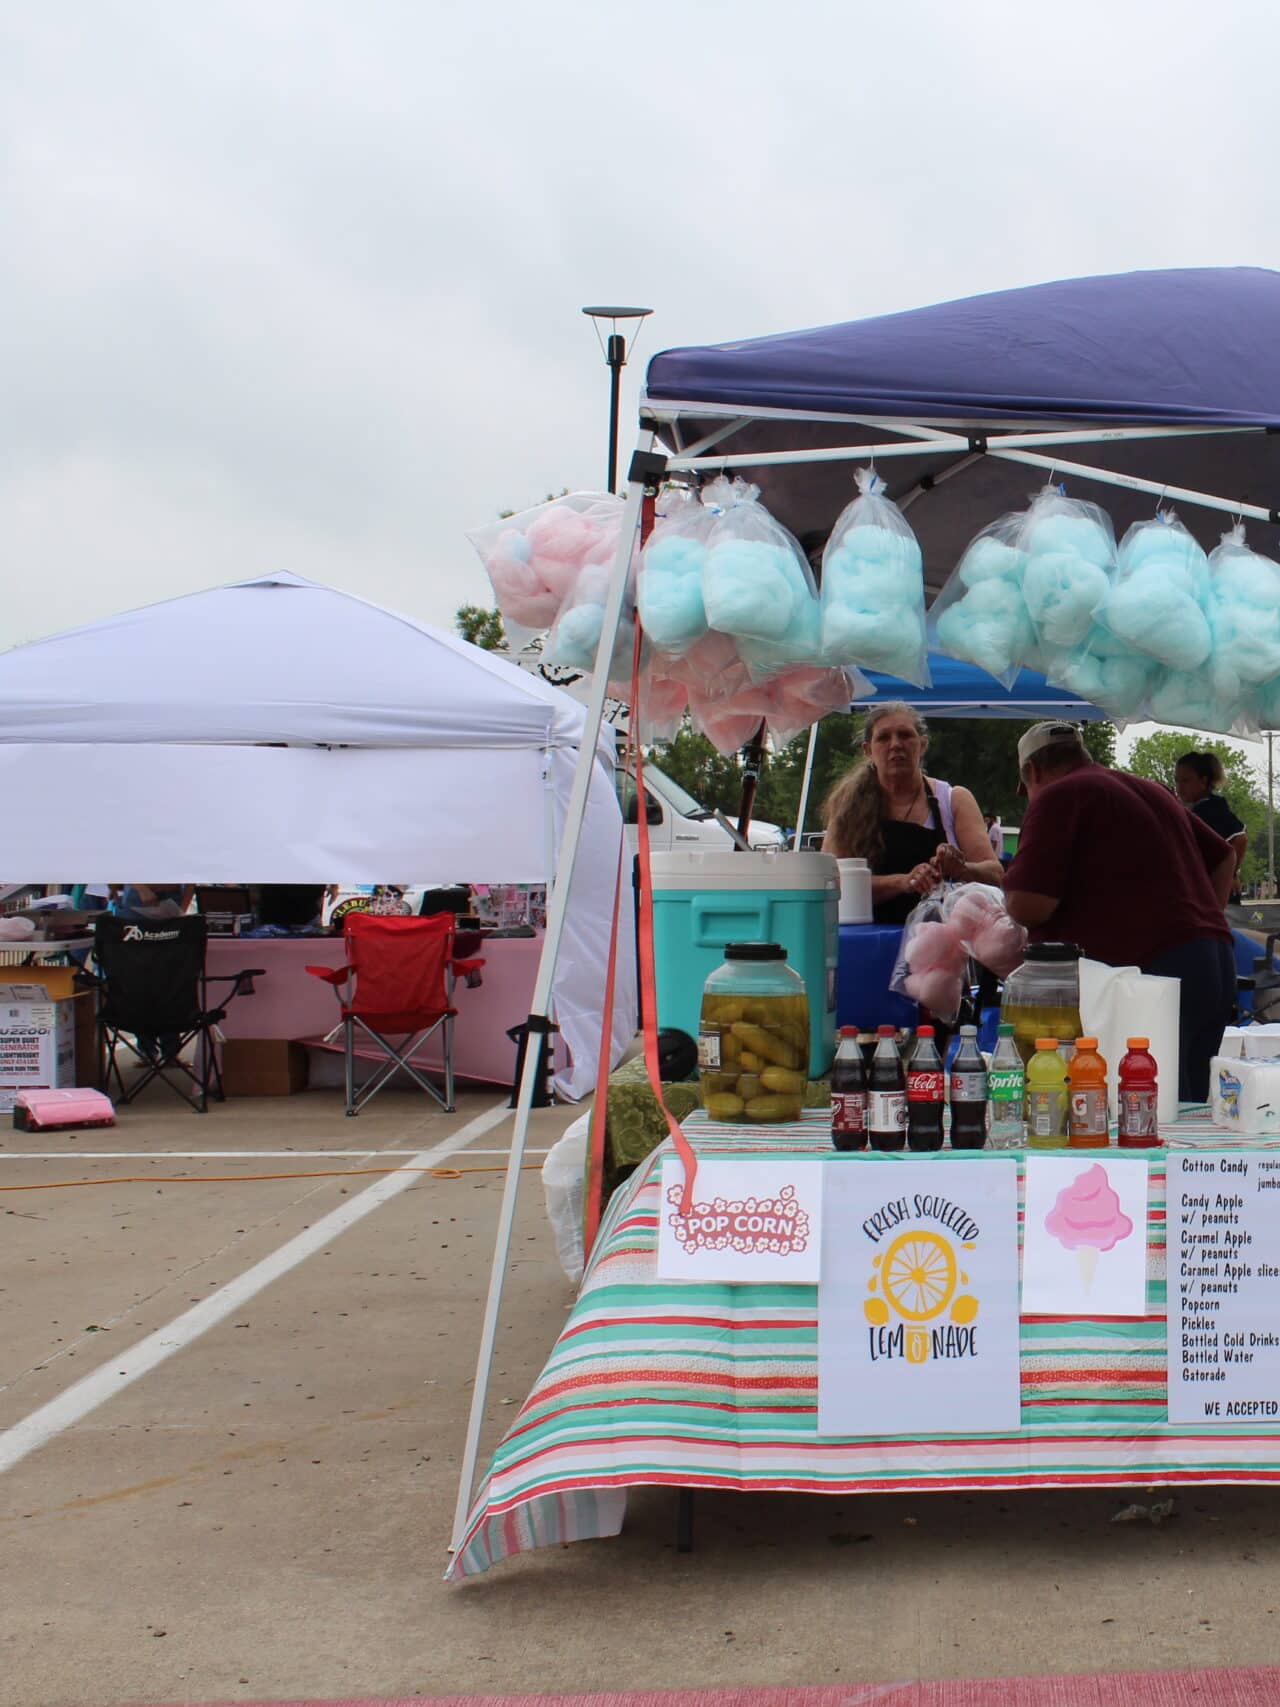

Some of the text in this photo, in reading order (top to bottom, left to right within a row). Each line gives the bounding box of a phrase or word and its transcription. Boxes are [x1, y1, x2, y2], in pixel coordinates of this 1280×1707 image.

[988, 1071, 1024, 1090] Sprite
[1182, 1158, 1215, 1173] Cotton
[1220, 1158, 1248, 1176] Candy
[1181, 1193, 1209, 1210] Candy
[1215, 1193, 1243, 1212] Apple
[688, 1216, 793, 1236] POP CORN
[862, 1193, 980, 1244] FRESH SQUEEZED
[1181, 1211, 1196, 1224] w/
[1202, 1211, 1239, 1227] peanuts
[1181, 1230, 1219, 1245] Caramel
[1224, 1230, 1252, 1248] Apple
[1181, 1247, 1196, 1260] w/
[1201, 1247, 1239, 1263] peanuts
[1180, 1263, 1218, 1277] Caramel
[1224, 1263, 1251, 1281] Apple
[1180, 1280, 1195, 1293] w/
[1201, 1281, 1238, 1296] peanuts
[1181, 1297, 1220, 1314] Popcorn
[1181, 1316, 1215, 1330] Pickles
[1182, 1333, 1218, 1347] Bottled
[1224, 1333, 1244, 1347] Cold
[1250, 1333, 1280, 1347] Drinks
[1182, 1350, 1218, 1364] Bottled
[1224, 1350, 1254, 1363] Water
[1182, 1367, 1226, 1382] Gatorade
[1204, 1401, 1220, 1416] WE
[1226, 1400, 1278, 1416] ACCEPTED
